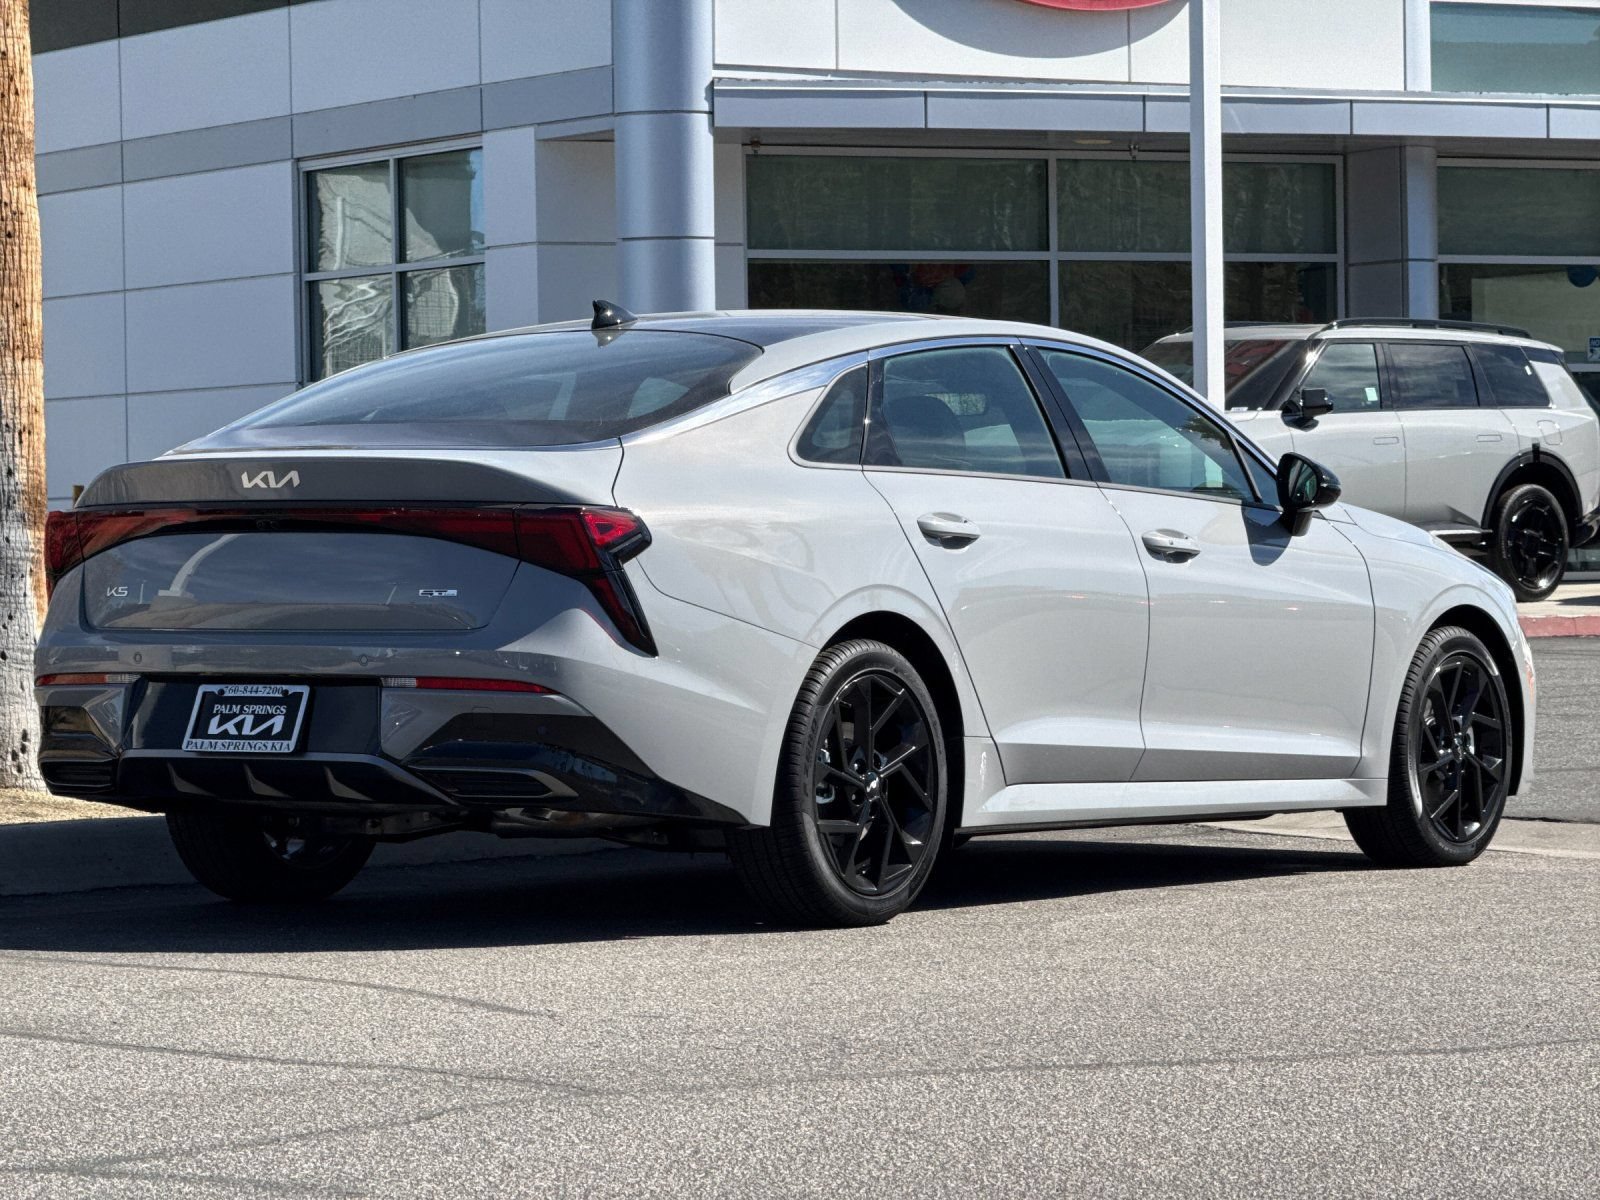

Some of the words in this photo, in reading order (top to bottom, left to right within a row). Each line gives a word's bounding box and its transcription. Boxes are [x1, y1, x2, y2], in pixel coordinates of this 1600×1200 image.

[241, 470, 300, 488] KIA
[107, 586, 128, 596] K5
[213, 704, 240, 714] PALM
[242, 705, 287, 715] SPRINGS
[207, 714, 284, 736] KIA
[185, 740, 219, 750] PALM
[219, 740, 268, 751] SPRINGS
[270, 741, 291, 751] KIA
